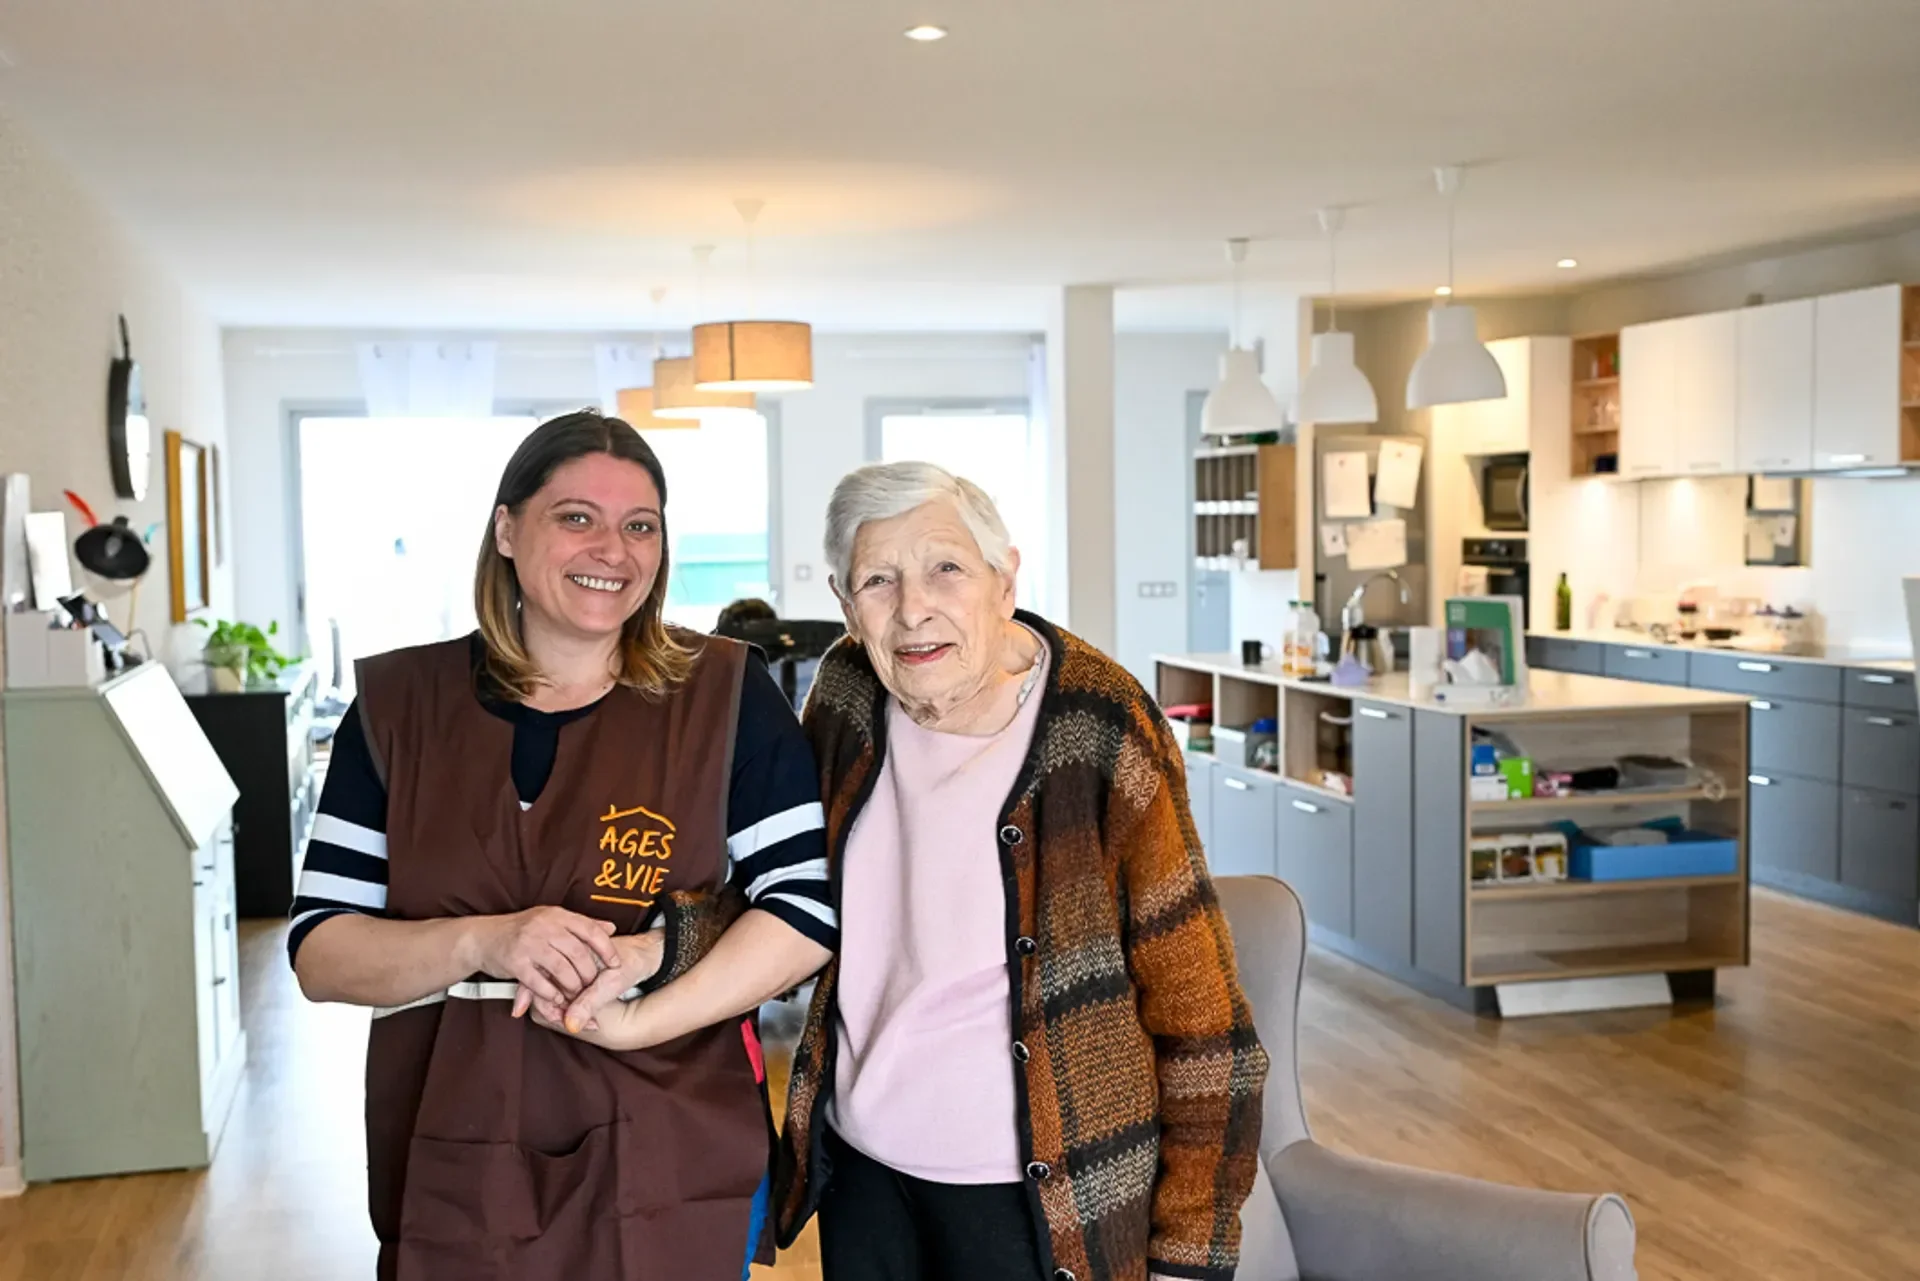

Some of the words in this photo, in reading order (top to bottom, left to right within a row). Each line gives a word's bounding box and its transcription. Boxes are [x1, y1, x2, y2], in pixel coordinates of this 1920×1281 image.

[600, 826, 674, 859] AGES
[594, 859, 622, 888] &
[624, 862, 669, 894] VIE
